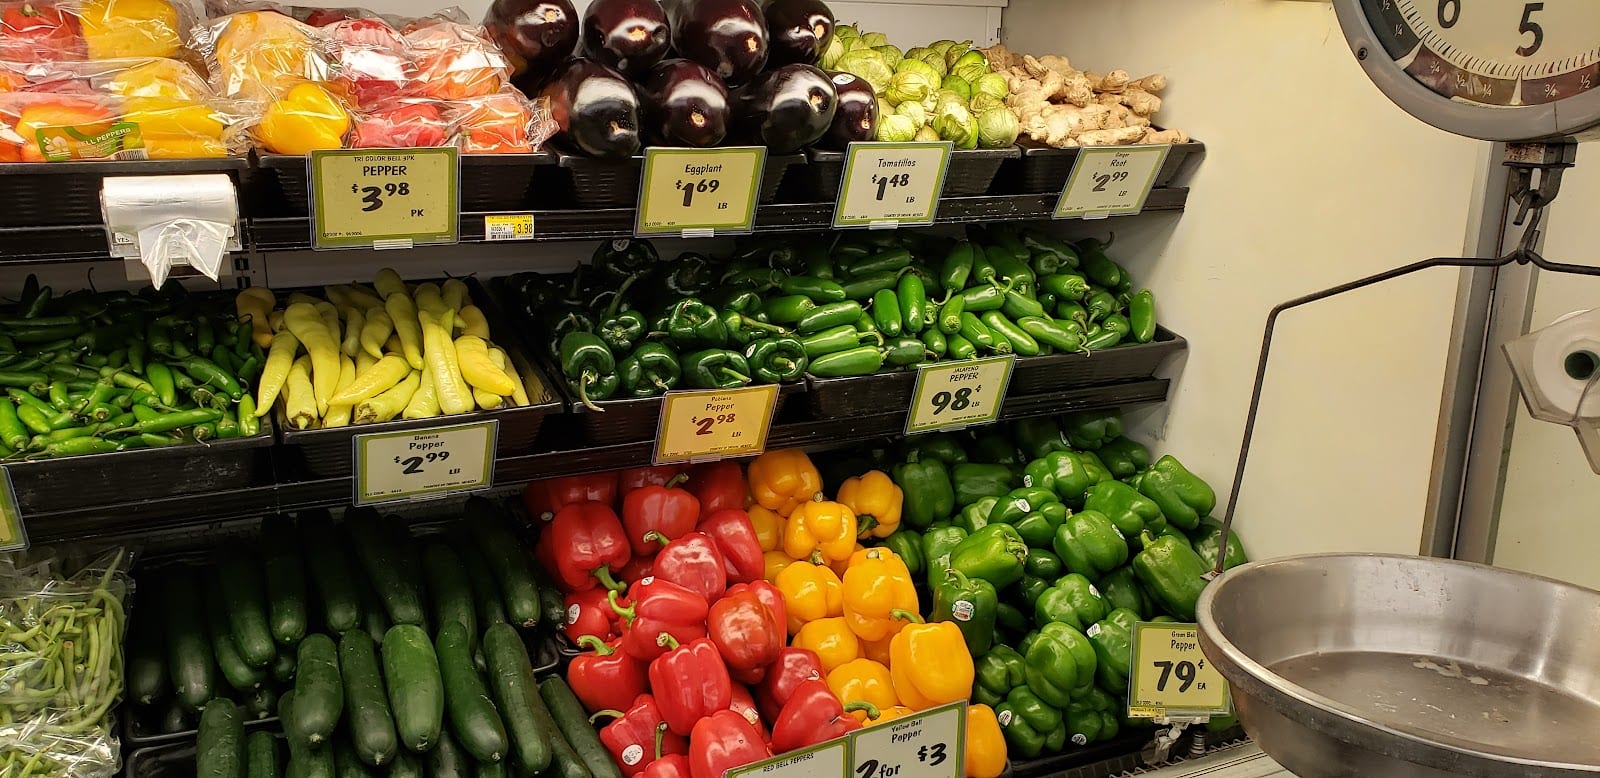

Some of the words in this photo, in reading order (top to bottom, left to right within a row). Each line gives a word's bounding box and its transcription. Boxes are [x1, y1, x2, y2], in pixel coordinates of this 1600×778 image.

[1515, 2, 1545, 58] 5
[96, 127, 132, 143] PEPPERS
[354, 155, 364, 163] TRI
[878, 158, 917, 168] Tomatillos
[1109, 159, 1128, 168] Root
[363, 165, 408, 177] PEPPER
[685, 163, 723, 176] Eggplant
[905, 196, 916, 204] LB
[717, 202, 729, 210] LB
[410, 208, 425, 218] PK
[949, 372, 980, 382] PEPPER
[705, 403, 735, 413] Pepper
[409, 441, 446, 451] Pepper
[1170, 639, 1196, 652] Pepper
[1197, 682, 1207, 691] EA
[891, 722, 910, 733] Yellow
[911, 719, 923, 728] Bell
[891, 729, 922, 744] Pepper
[917, 742, 947, 767] $3
[763, 764, 774, 773] RED
[776, 760, 789, 770] BELL
[790, 752, 814, 765] PEPPERS
